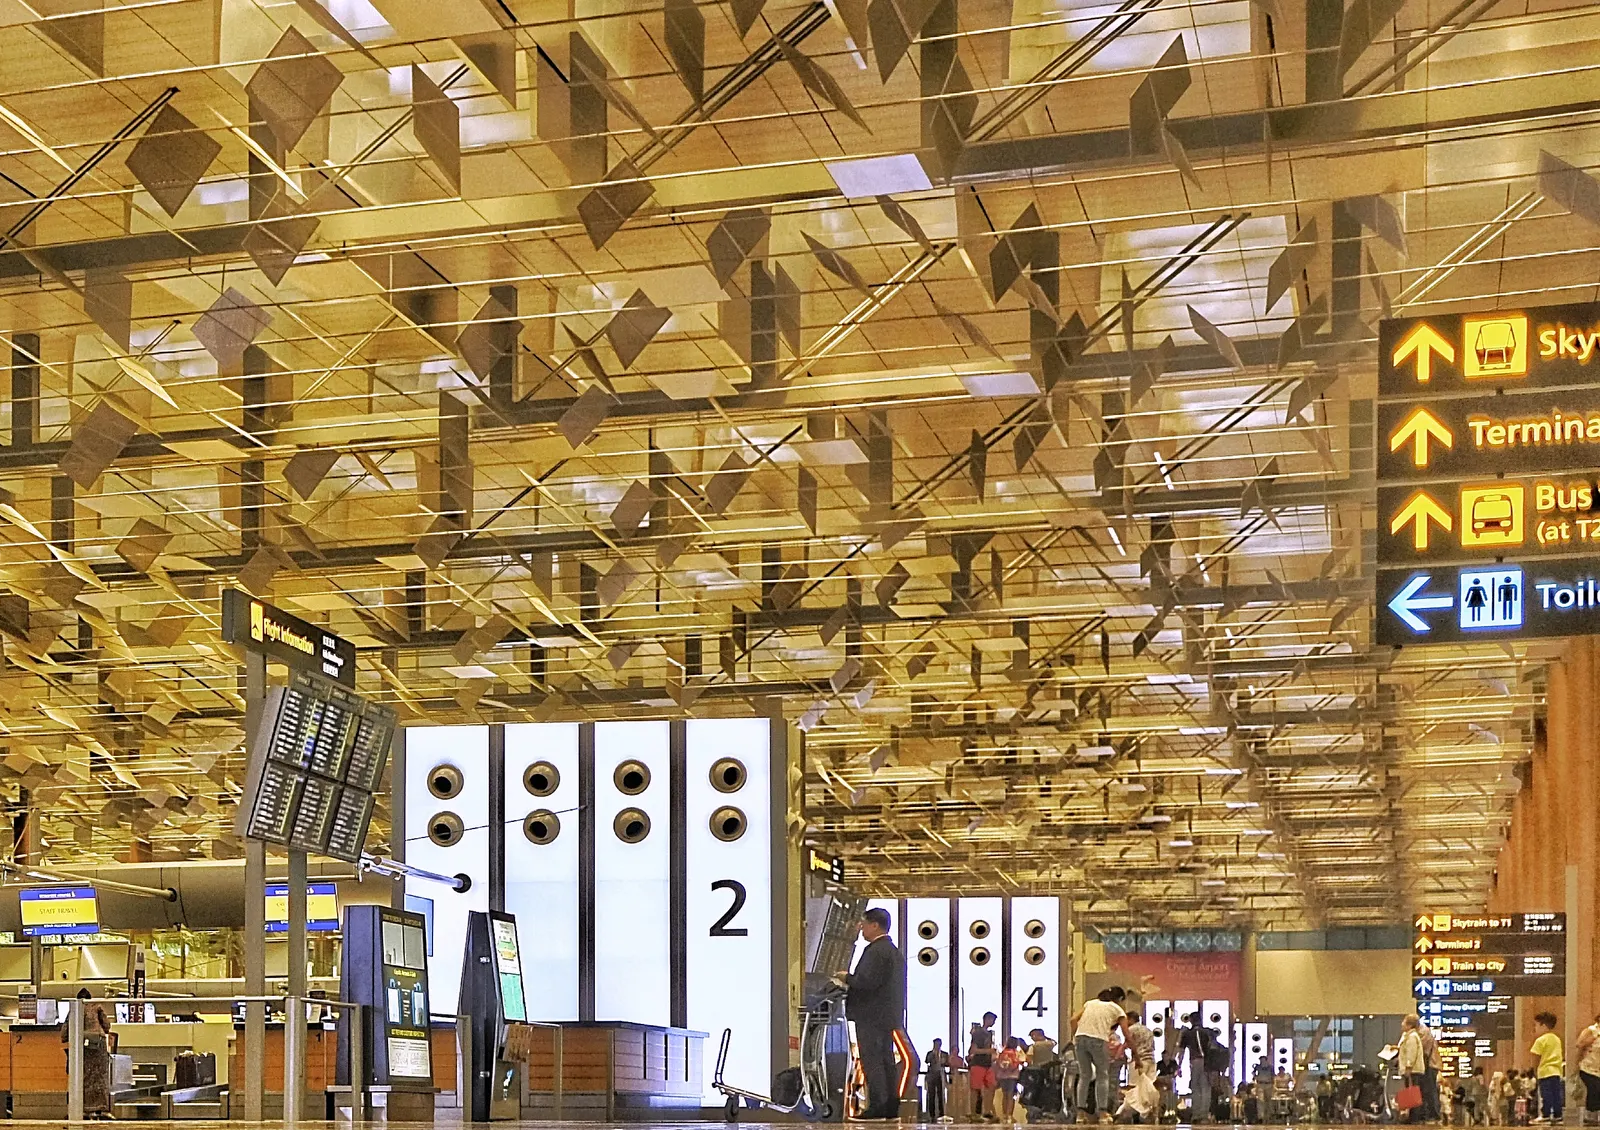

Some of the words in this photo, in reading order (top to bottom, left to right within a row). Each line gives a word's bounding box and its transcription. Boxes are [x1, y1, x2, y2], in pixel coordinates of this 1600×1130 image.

[1536, 485, 1592, 511] Bus
[1536, 521, 1570, 544] (at
[1535, 579, 1600, 609] Toil
[263, 617, 280, 642] Flight
[281, 625, 315, 656] Information
[708, 878, 748, 937] 2
[1022, 986, 1048, 1017] 4
